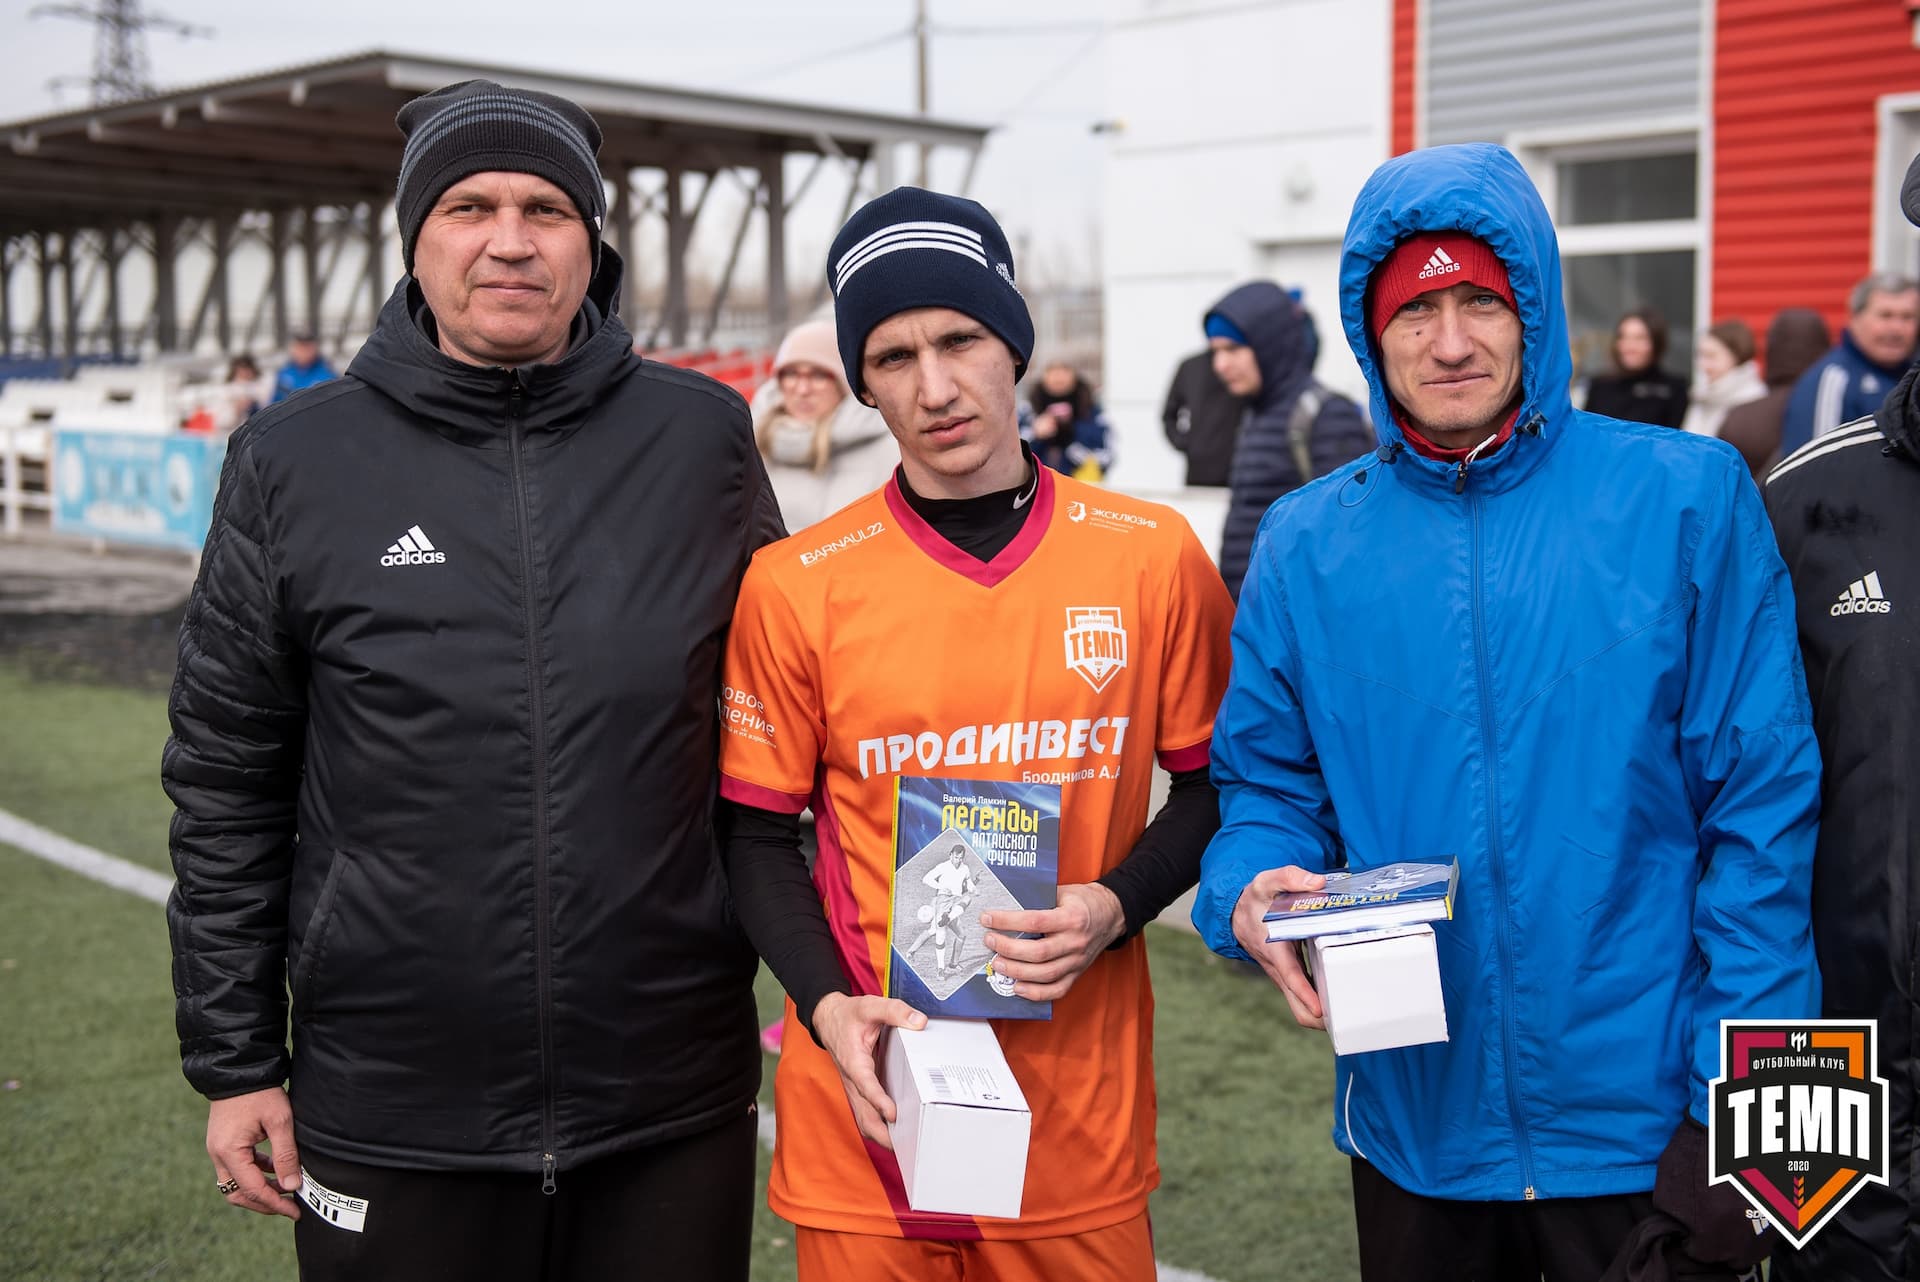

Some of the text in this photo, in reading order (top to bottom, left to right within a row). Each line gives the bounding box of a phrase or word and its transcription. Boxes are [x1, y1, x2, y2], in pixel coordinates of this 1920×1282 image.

[1419, 262, 1461, 279] adidas
[1091, 507, 1157, 528] ЭКСКЛЮЗИВ
[800, 522, 885, 566] BARNAUL22
[380, 550, 446, 567] adidas
[1830, 597, 1891, 616] adidas
[1069, 630, 1123, 661] ТЕМП
[858, 716, 1130, 780] ПРОДИНВЕСТ
[1022, 768, 1095, 785] Бродников
[943, 794, 976, 804] Валерий
[972, 832, 1038, 850] АЛТАЙСКОГО
[987, 849, 1037, 867] ФУТБОЛА
